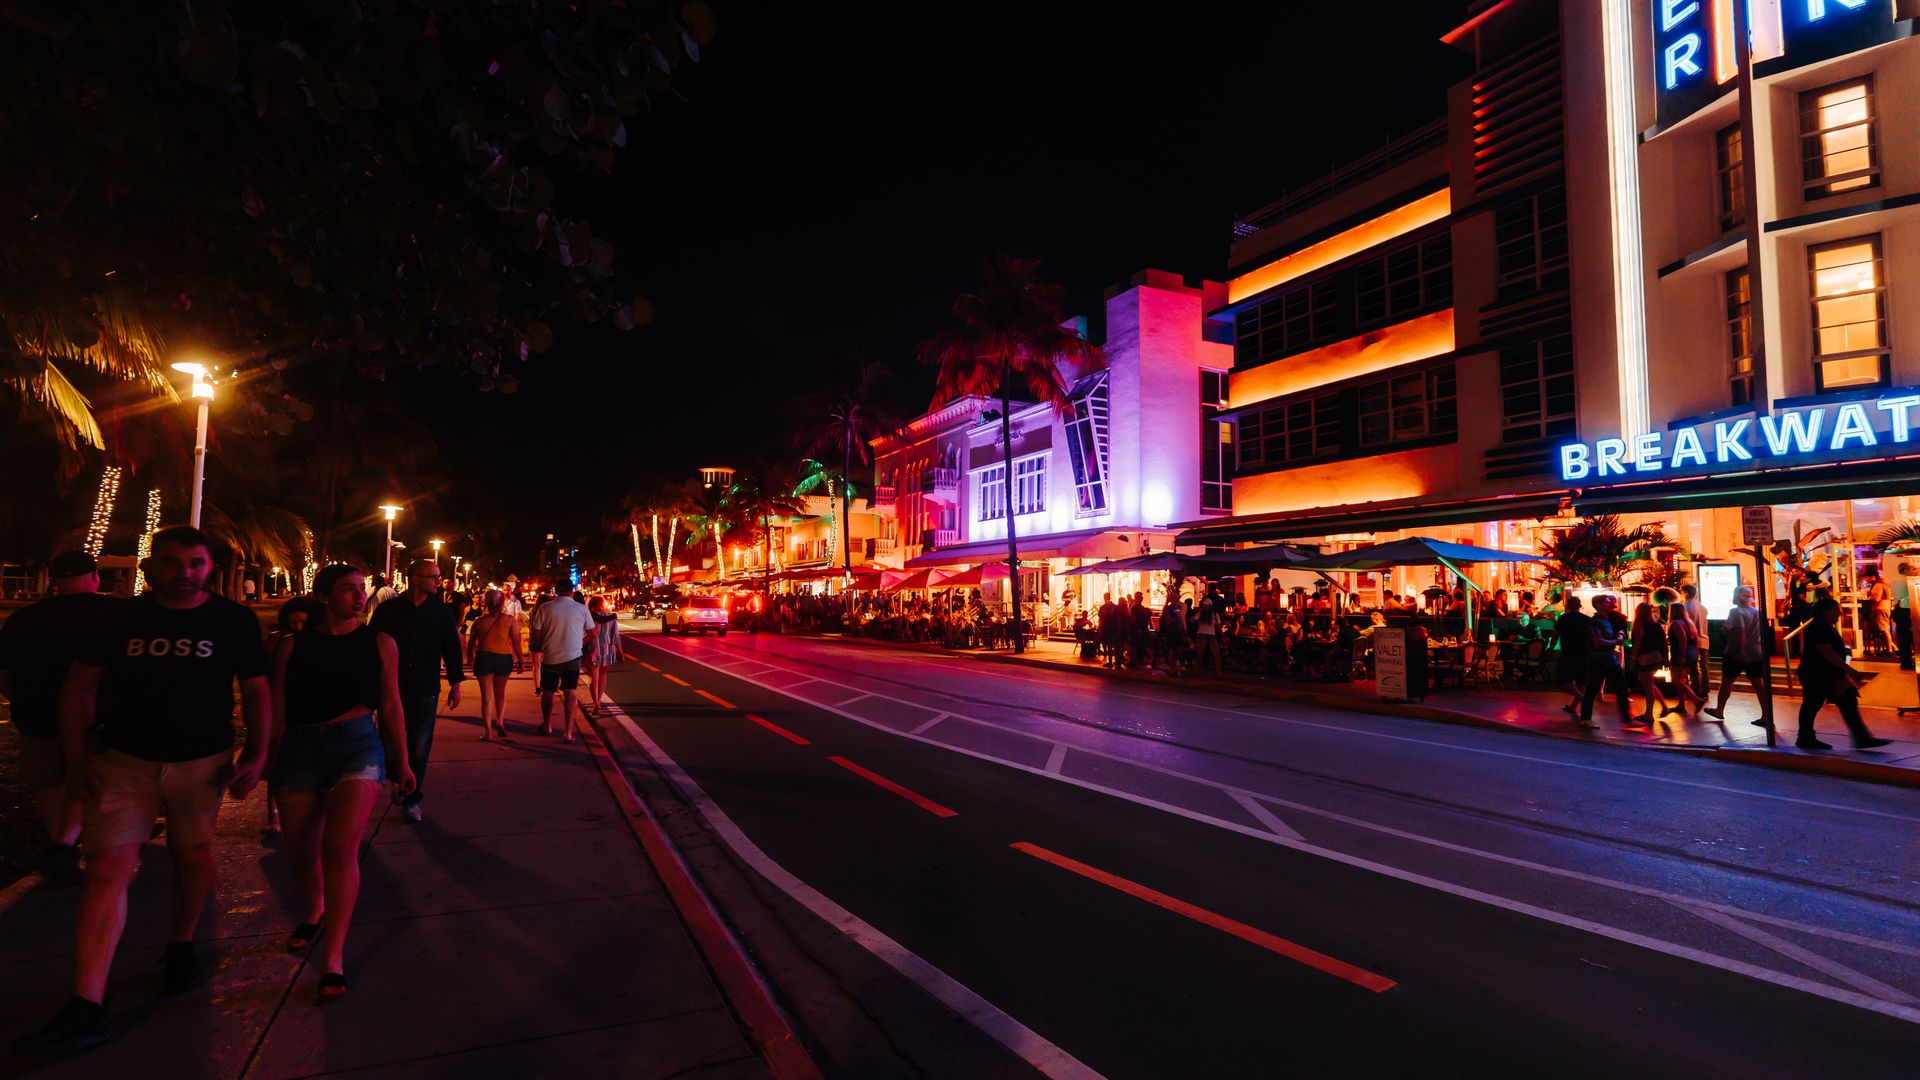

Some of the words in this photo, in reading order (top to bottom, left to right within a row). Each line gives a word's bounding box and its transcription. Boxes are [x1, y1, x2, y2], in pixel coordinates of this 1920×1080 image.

[1560, 394, 1920, 481] BREAKWAT
[126, 638, 214, 658] BOSS
[1377, 645, 1402, 656] VALET
